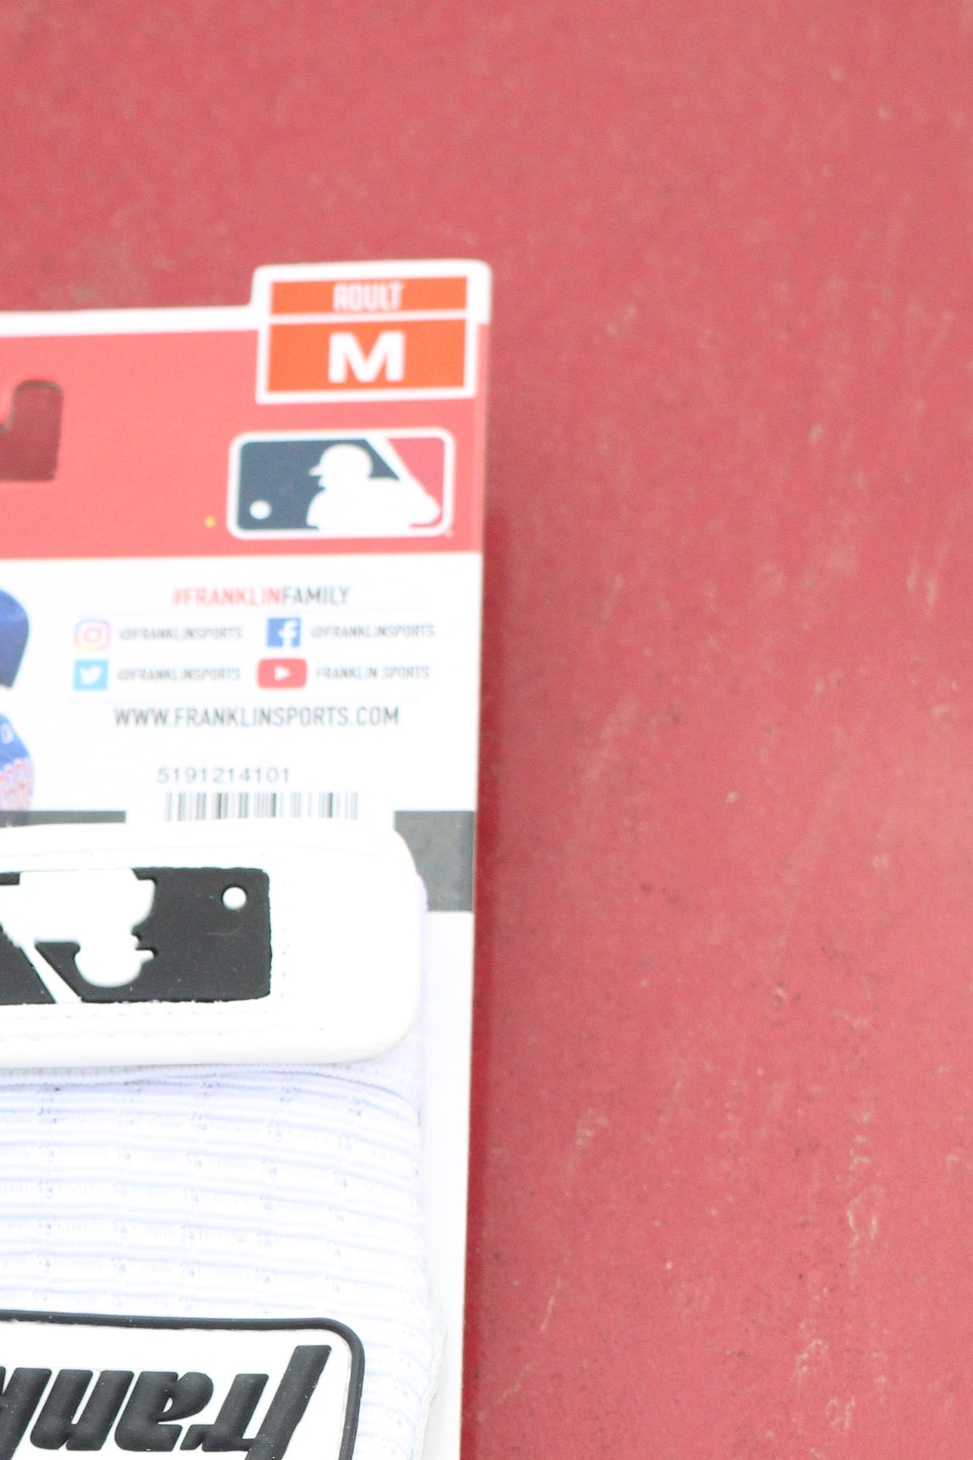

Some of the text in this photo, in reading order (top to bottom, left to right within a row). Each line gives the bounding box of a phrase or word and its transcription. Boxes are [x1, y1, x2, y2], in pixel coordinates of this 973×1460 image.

[332, 281, 403, 312] ADULT
[329, 331, 405, 383] M
[172, 586, 350, 607] #FRANKLINFAMILY
[119, 626, 243, 641] @FRANKLINSPORTS
[310, 623, 436, 639] @FRANKLINSPORTS
[117, 666, 241, 682] @FRANKLINSPORTS
[316, 665, 430, 681] FRANKLIN SPORTS
[114, 706, 400, 728] WWW.FRANKLINSPORTS.COM
[157, 766, 291, 784] 5191214101
